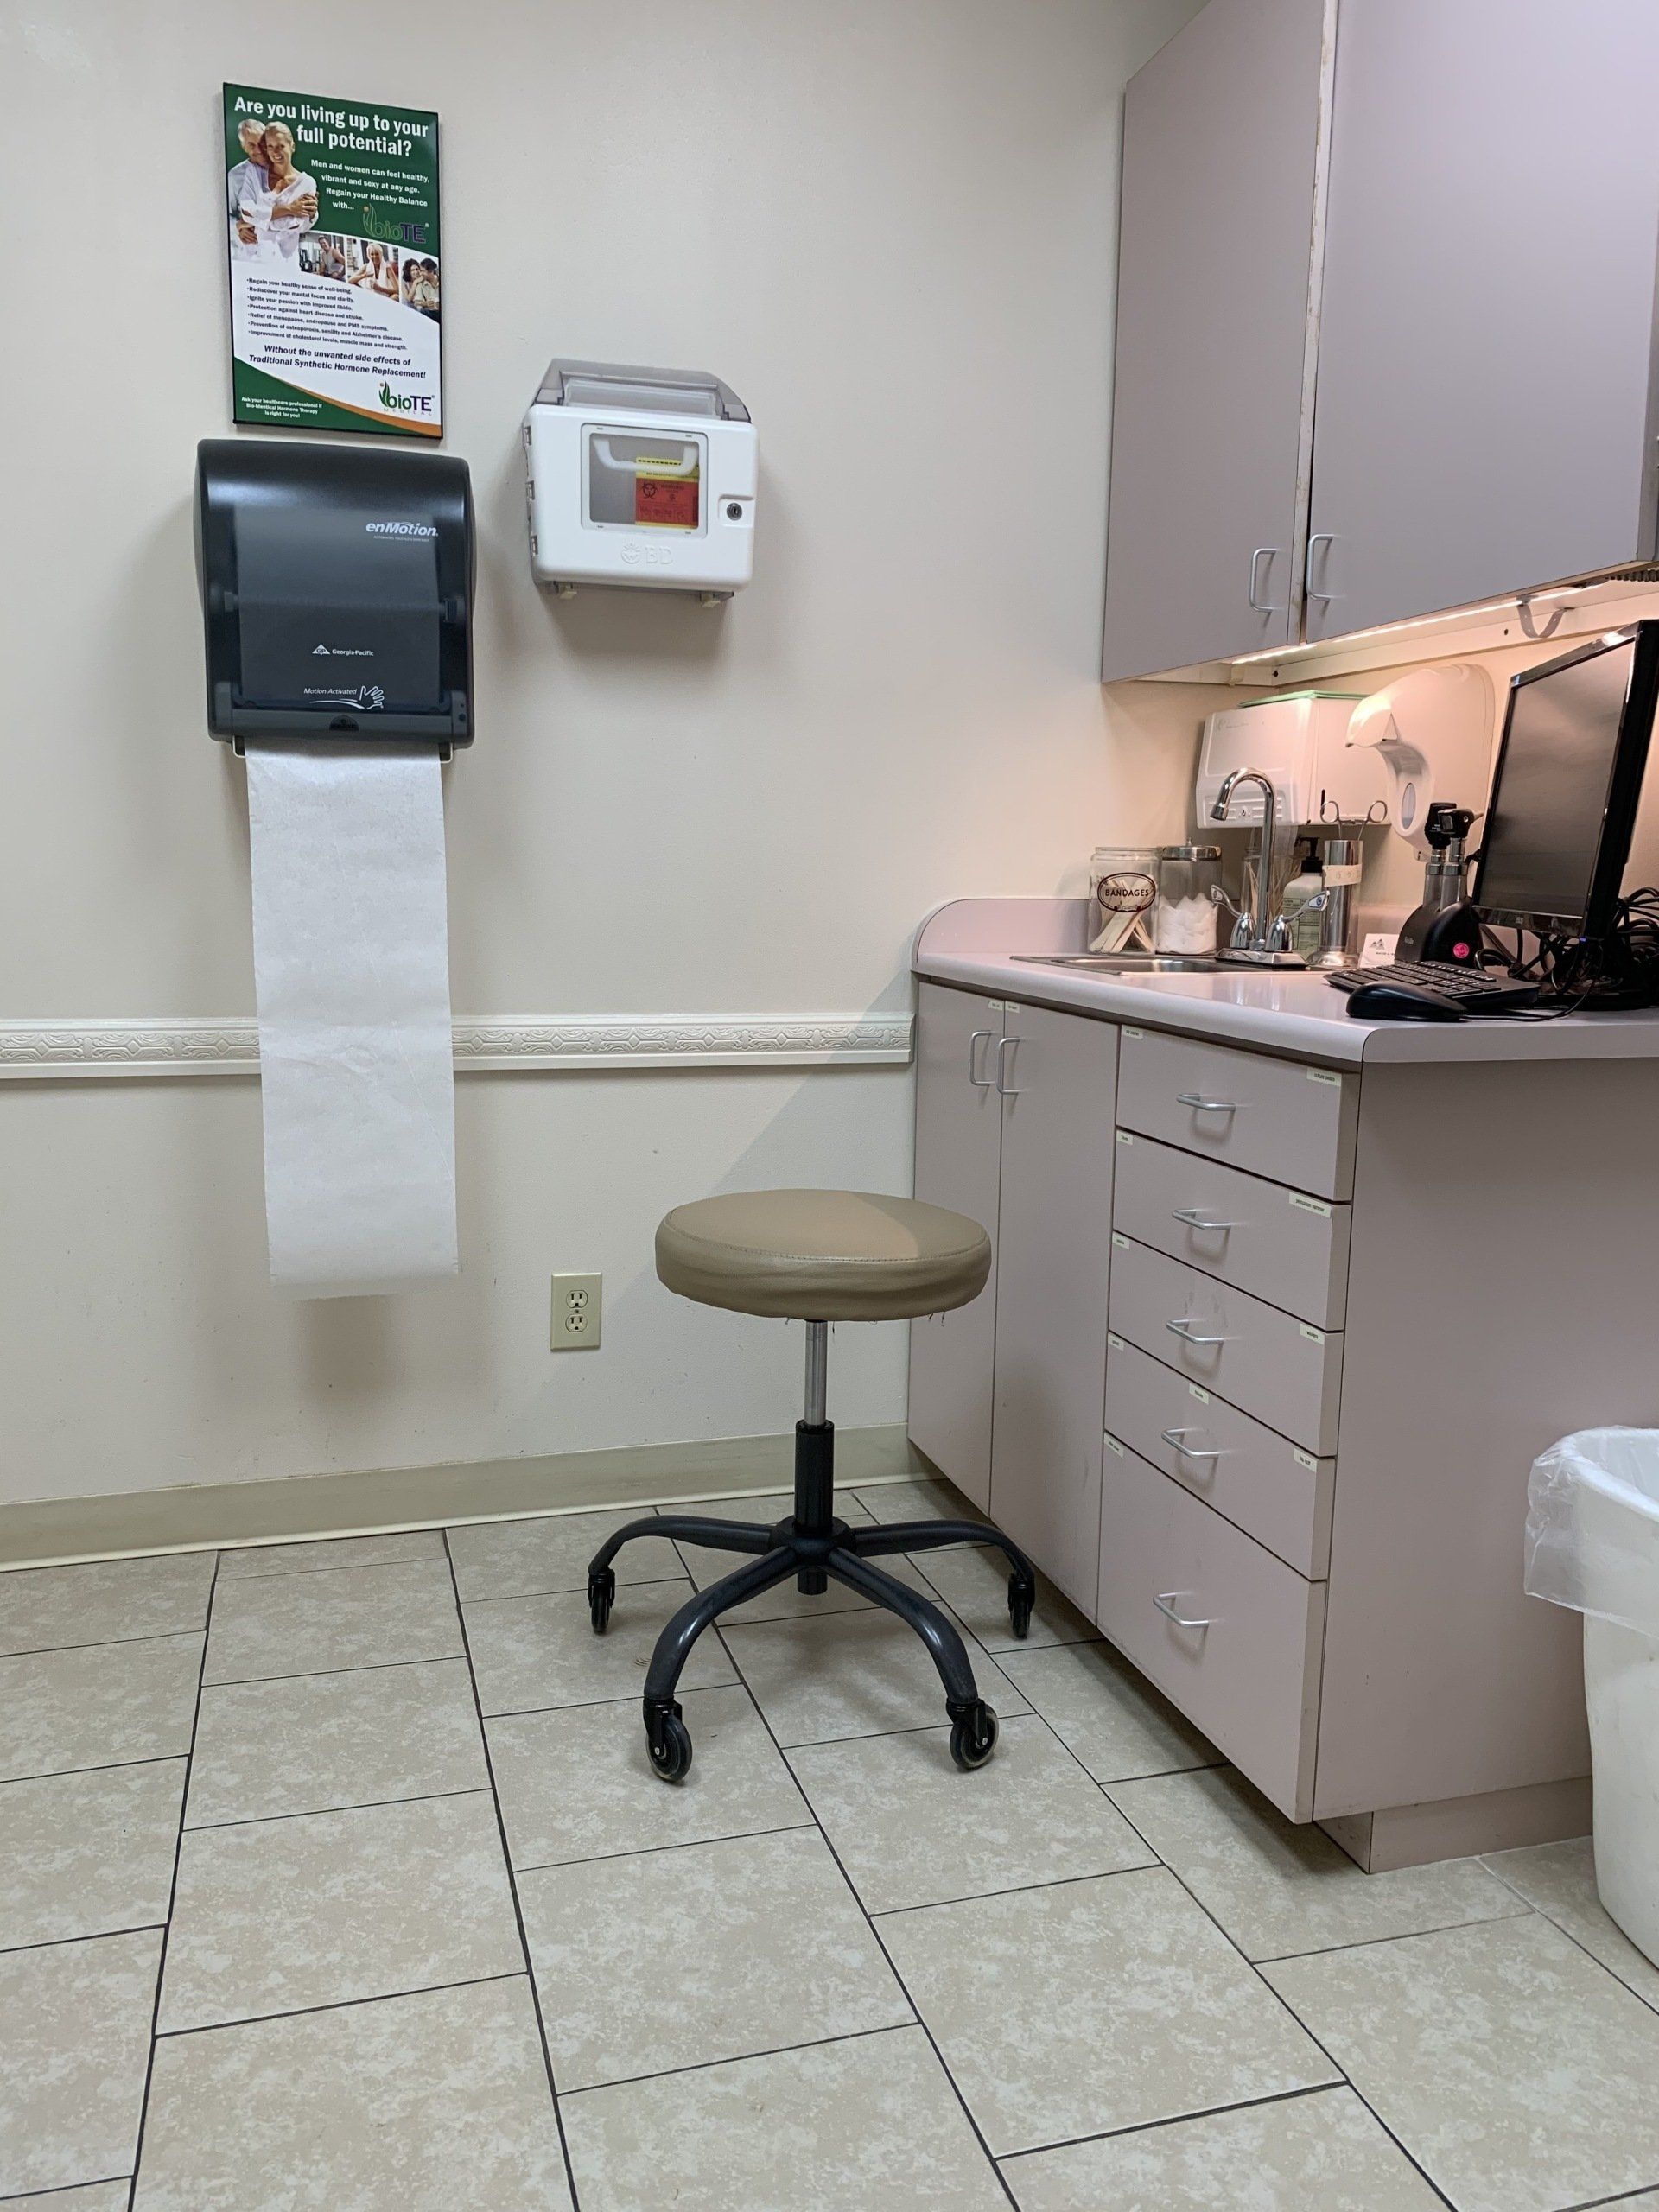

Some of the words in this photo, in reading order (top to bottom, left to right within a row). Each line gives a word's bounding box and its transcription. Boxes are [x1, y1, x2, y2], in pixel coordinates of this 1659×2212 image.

[234, 96, 264, 114] Are
[267, 103, 296, 119] you
[301, 104, 346, 129] living
[349, 114, 370, 131] up
[373, 114, 390, 131] to
[393, 120, 429, 137] your
[297, 124, 324, 144] full
[328, 132, 412, 156] potential?
[311, 159, 327, 168] Men
[328, 162, 343, 170] and
[344, 164, 371, 175] women
[372, 168, 385, 176] can
[386, 169, 400, 178] feel
[402, 171, 430, 183] healthy,
[321, 174, 347, 184] vibrant
[348, 176, 362, 186] and
[363, 180, 380, 189] sexy
[381, 181, 390, 190] at
[390, 183, 404, 193] any
[404, 185, 421, 194] age.
[326, 187, 351, 197] Regain
[370, 193, 397, 204] Healthy
[398, 196, 428, 207] Balance
[332, 200, 354, 210] with...
[249, 354, 293, 365] Traditional
[294, 359, 333, 369] Synthetic
[334, 363, 370, 373] Hormone
[372, 366, 426, 378] Replacement!
[264, 345, 296, 355] Without
[298, 348, 312, 357] the
[314, 350, 353, 360] unwanted
[355, 353, 372, 362] side
[373, 355, 401, 366] effects
[378, 380, 432, 412] bioTE
[332, 648, 374, 657] Georgia-Pacific
